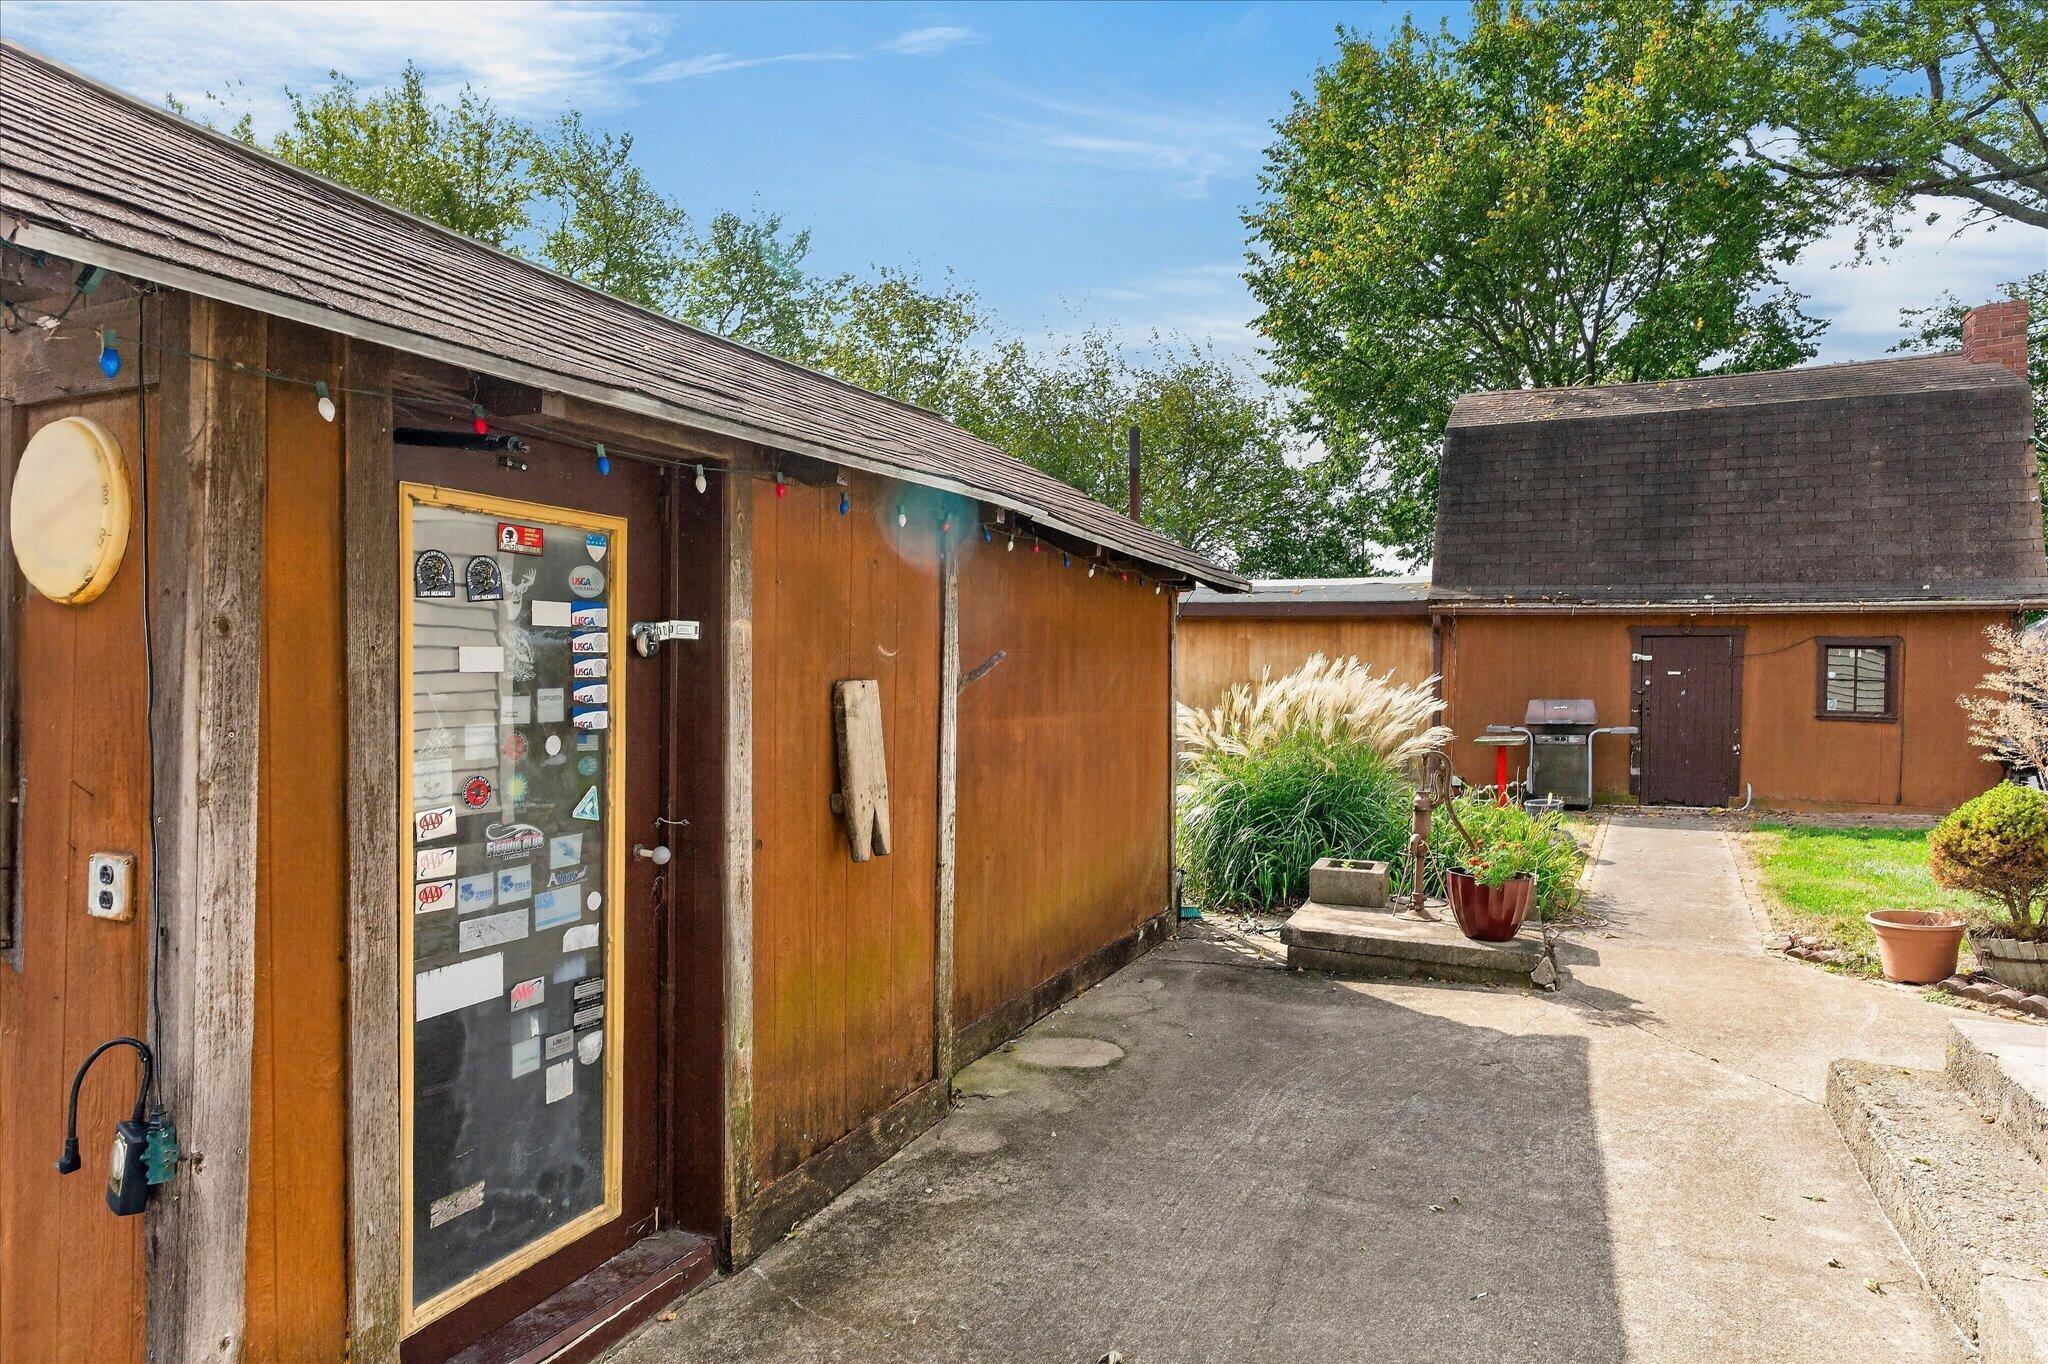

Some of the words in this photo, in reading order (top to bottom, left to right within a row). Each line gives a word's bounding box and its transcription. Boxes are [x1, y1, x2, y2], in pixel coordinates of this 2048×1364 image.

[571, 577, 591, 587] USGA
[574, 616, 595, 626] USGA
[574, 641, 594, 651] USGA
[575, 667, 594, 676] USGA
[574, 693, 594, 703] USGA
[574, 720, 594, 729] USGA
